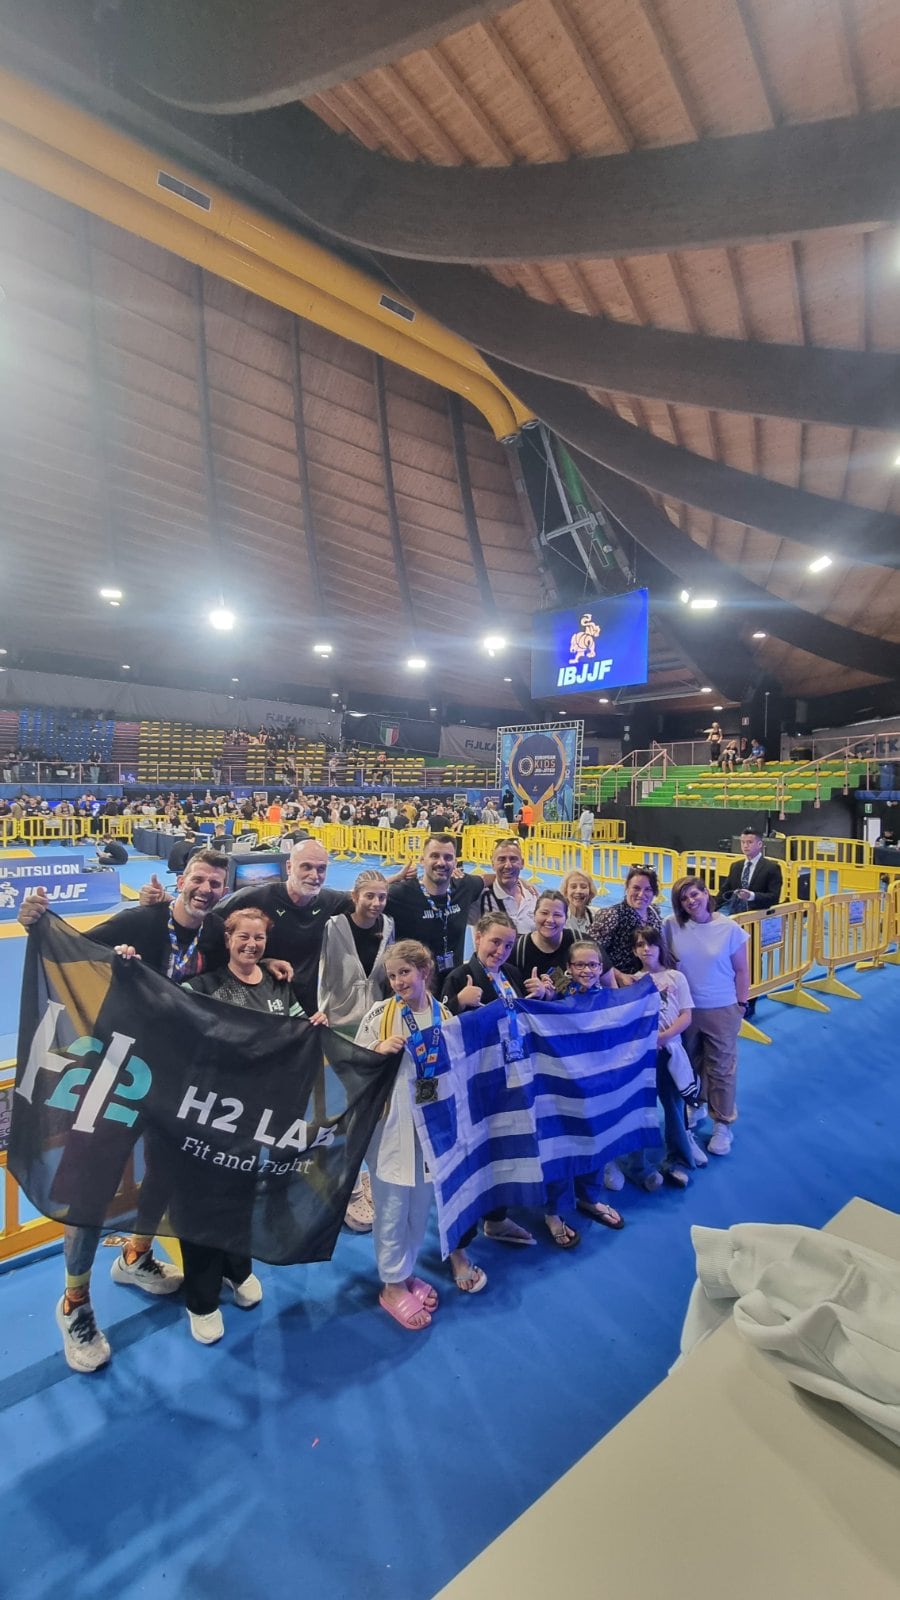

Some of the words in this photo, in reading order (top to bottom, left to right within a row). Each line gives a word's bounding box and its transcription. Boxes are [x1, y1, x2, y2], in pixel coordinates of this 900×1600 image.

[557, 659, 613, 687] IBJJF
[534, 760, 556, 768] KIDS
[53, 863, 79, 875] CON
[176, 1085, 244, 1134] H2
[253, 1108, 338, 1153] LAB
[181, 1136, 212, 1160] Fit
[213, 1151, 257, 1172] and
[258, 1157, 314, 1176] Fight
